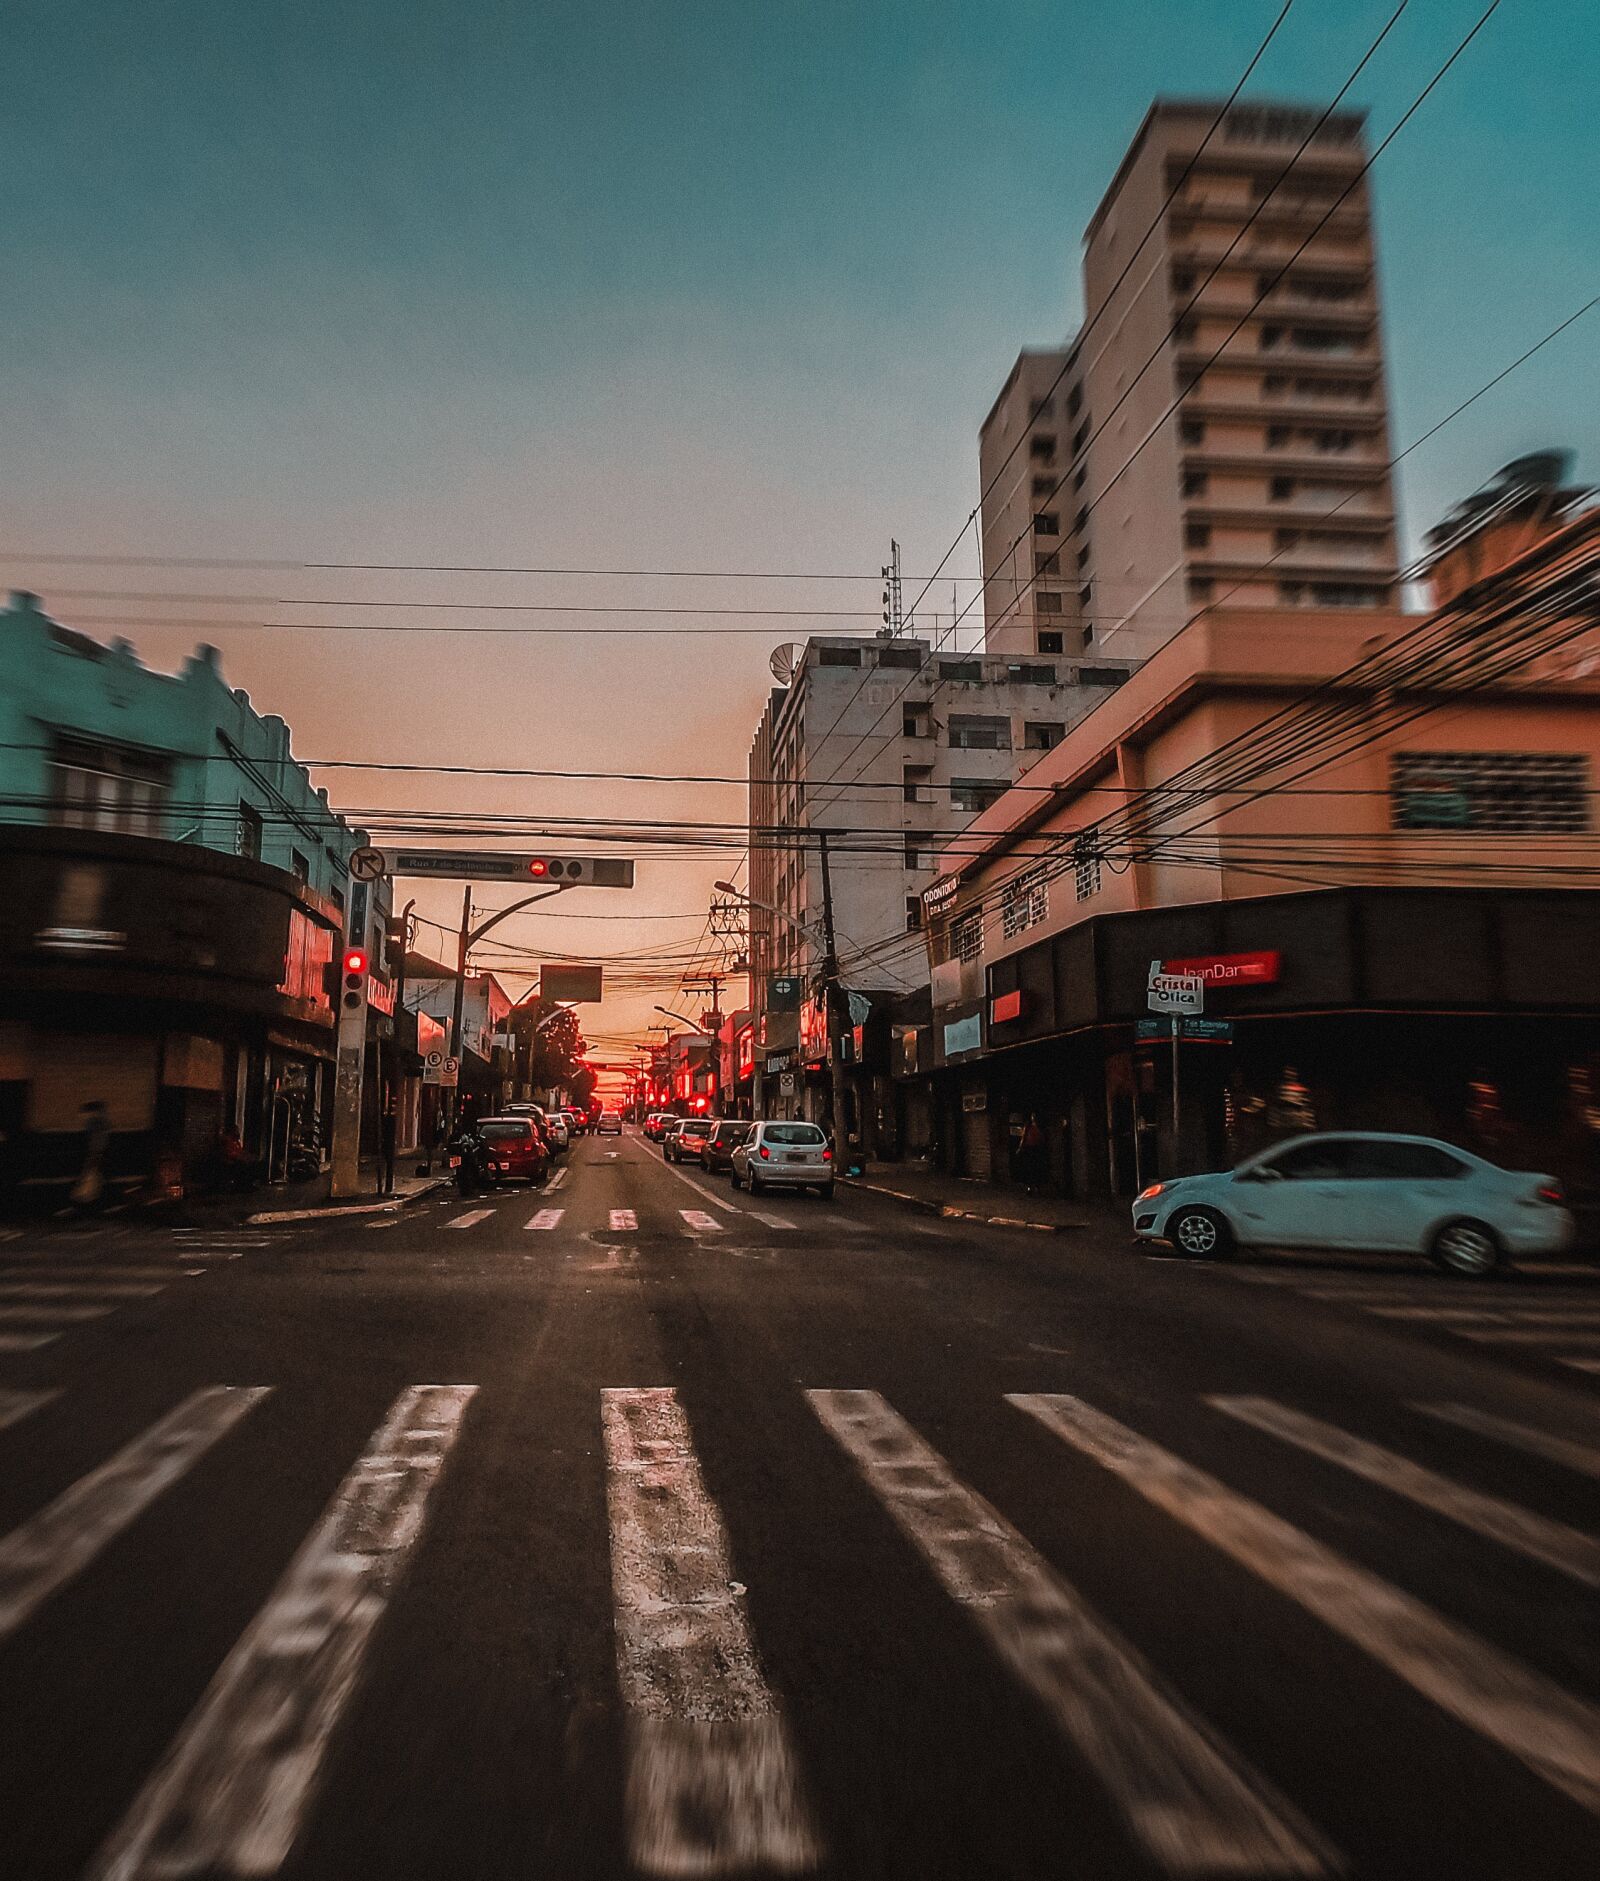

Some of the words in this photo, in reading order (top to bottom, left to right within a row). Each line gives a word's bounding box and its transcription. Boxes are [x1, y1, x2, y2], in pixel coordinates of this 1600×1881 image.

[409, 859, 429, 867] Rua
[1152, 977, 1199, 992] Cristal
[432, 1055, 437, 1063] E
[447, 1061, 452, 1070] E
